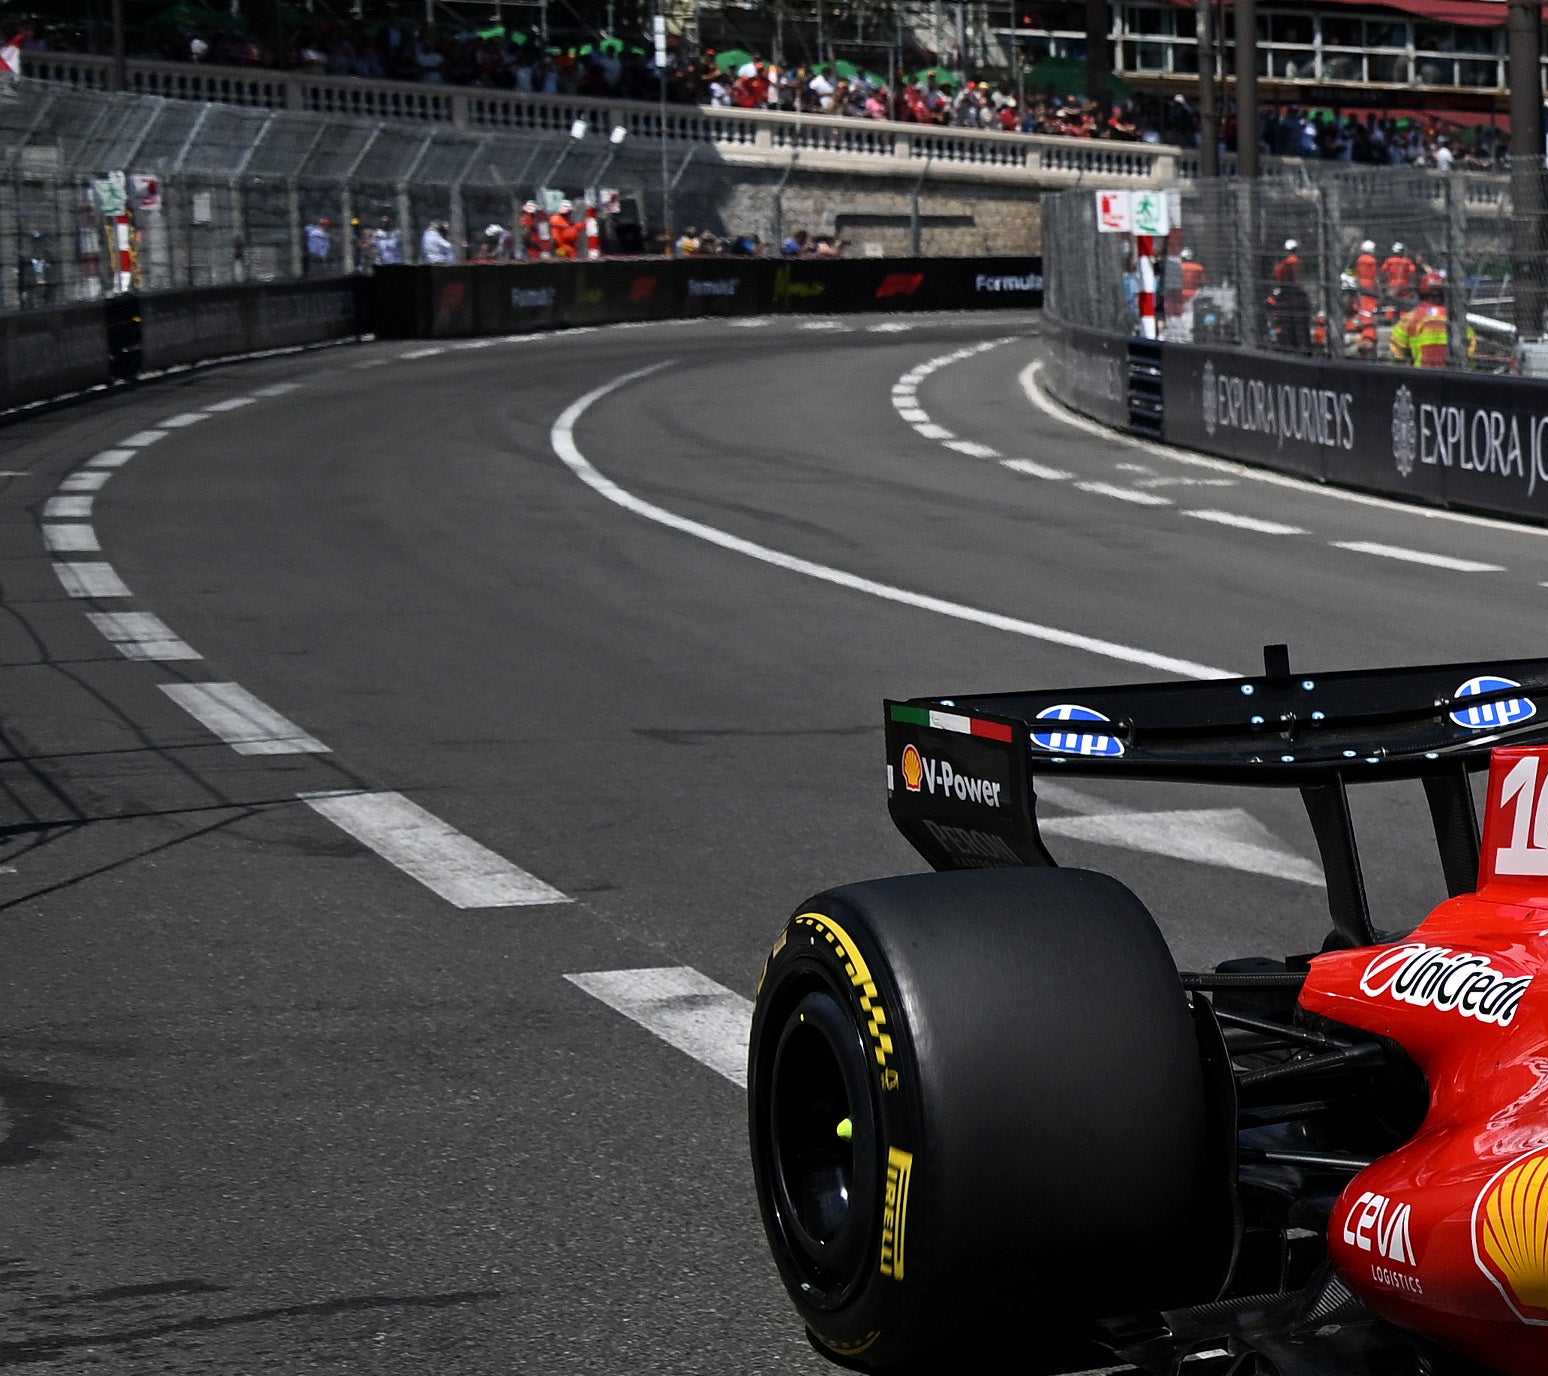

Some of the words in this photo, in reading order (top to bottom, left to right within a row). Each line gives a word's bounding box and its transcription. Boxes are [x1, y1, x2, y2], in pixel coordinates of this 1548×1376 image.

[1218, 375, 1278, 434] EXPLORA
[1278, 384, 1354, 450] JOURNEYS
[1420, 403, 1522, 478] EXPLORA
[922, 756, 1001, 808] V-Power
[880, 1146, 914, 1281] PIRELLI
[1371, 1263, 1424, 1295] LOGISTICS
